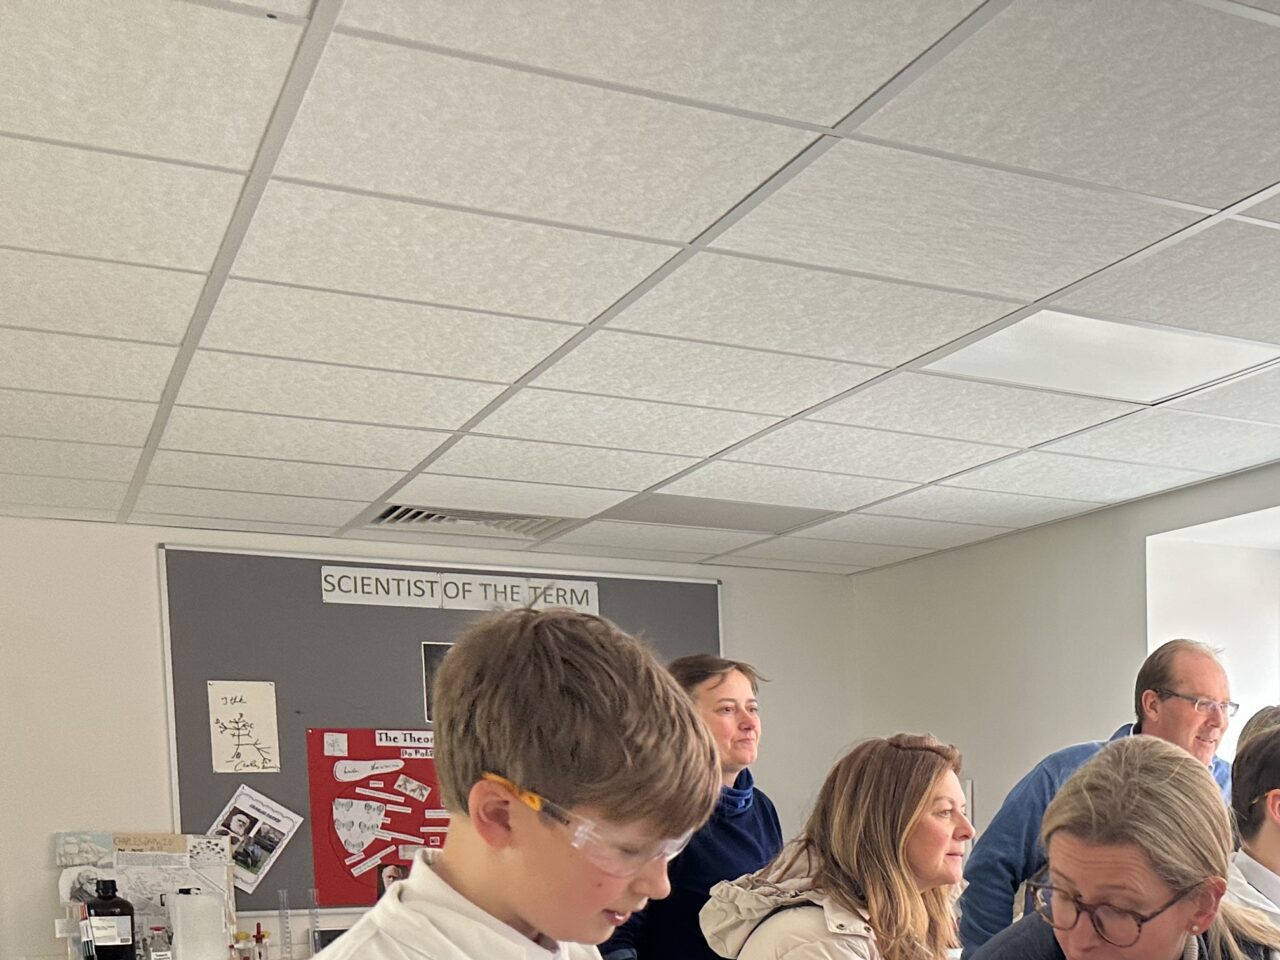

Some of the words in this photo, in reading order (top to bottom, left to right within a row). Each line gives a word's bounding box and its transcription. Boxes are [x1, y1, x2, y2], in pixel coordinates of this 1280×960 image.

[323, 574, 439, 598] SCIENTIST
[443, 581, 473, 600] OF
[479, 583, 521, 603] THE
[528, 585, 590, 607] TERM
[377, 732, 399, 743] The
[401, 732, 433, 744] Theor
